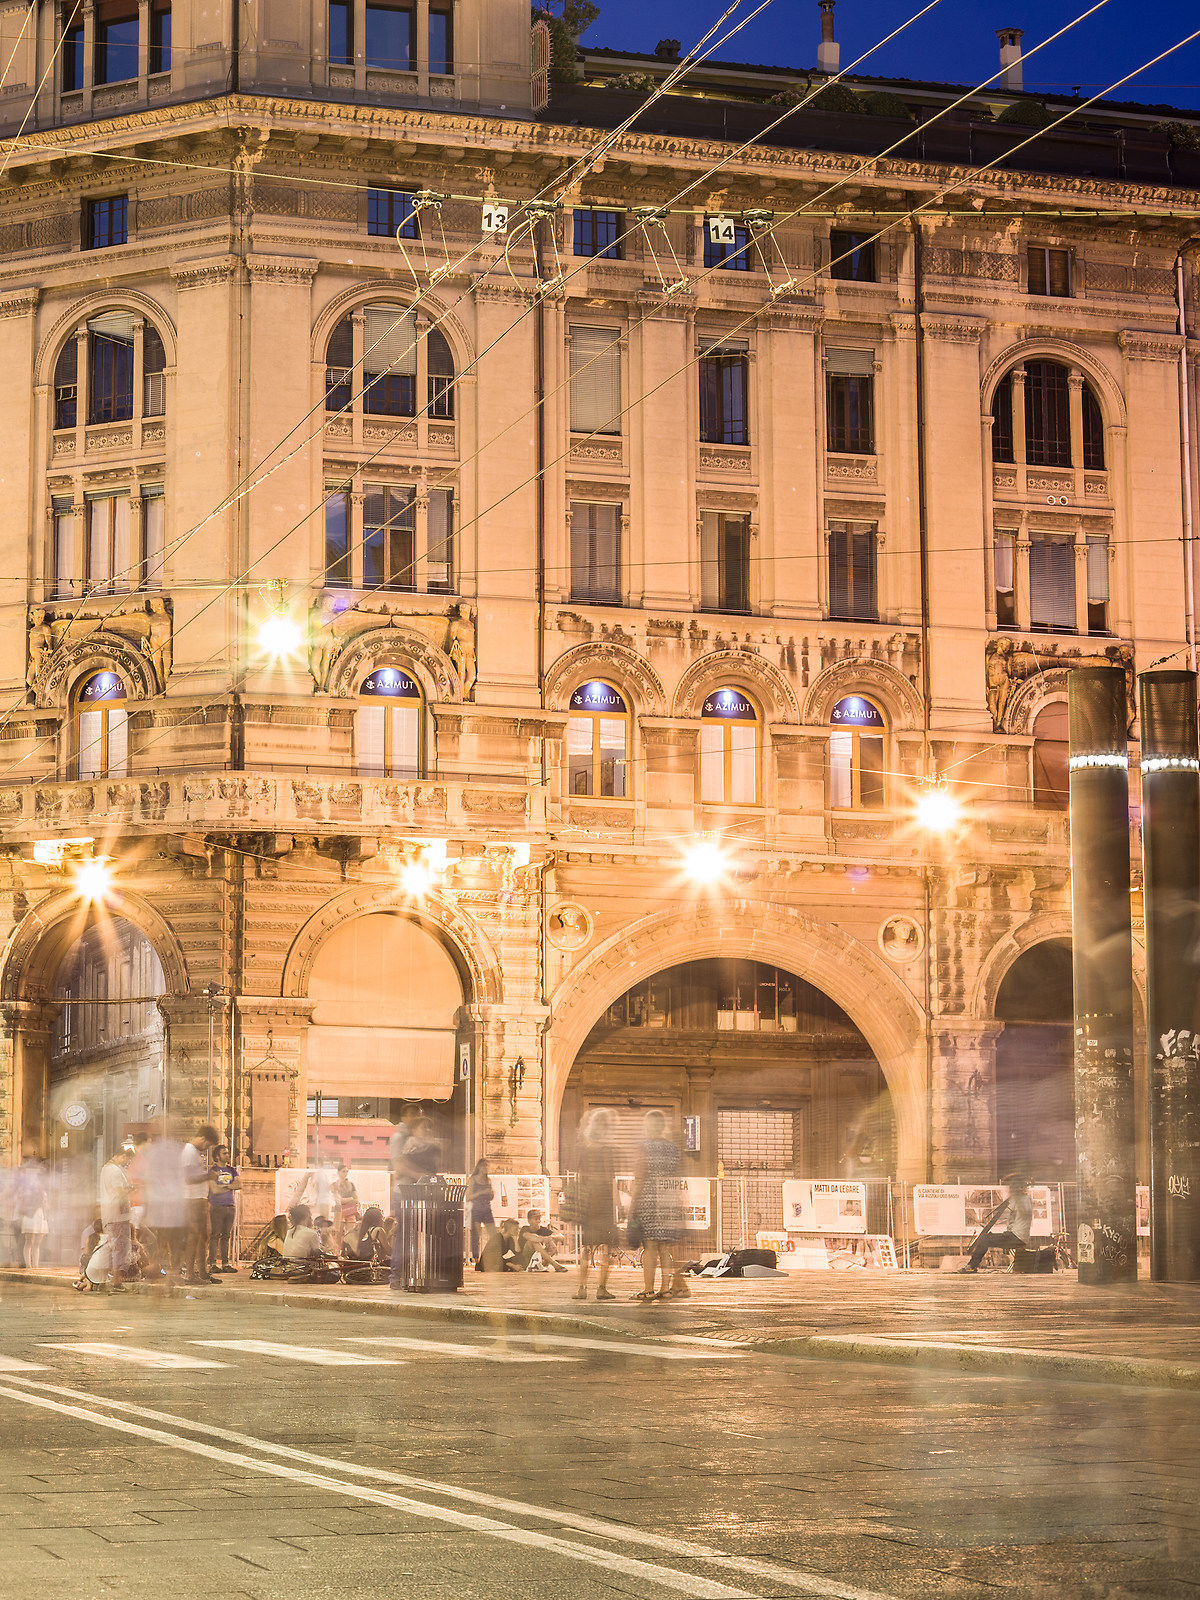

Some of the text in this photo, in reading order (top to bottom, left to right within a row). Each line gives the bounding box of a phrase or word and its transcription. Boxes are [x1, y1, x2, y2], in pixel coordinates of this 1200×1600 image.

[484, 212, 506, 229] 13
[712, 225, 733, 240] 14
[377, 680, 414, 689] AZIMUT
[584, 695, 620, 704] AZIMUT
[715, 702, 750, 712] AZIMUT
[843, 709, 878, 718] AZIMUT
[814, 1184, 860, 1194] MATTI DA LEGARE
